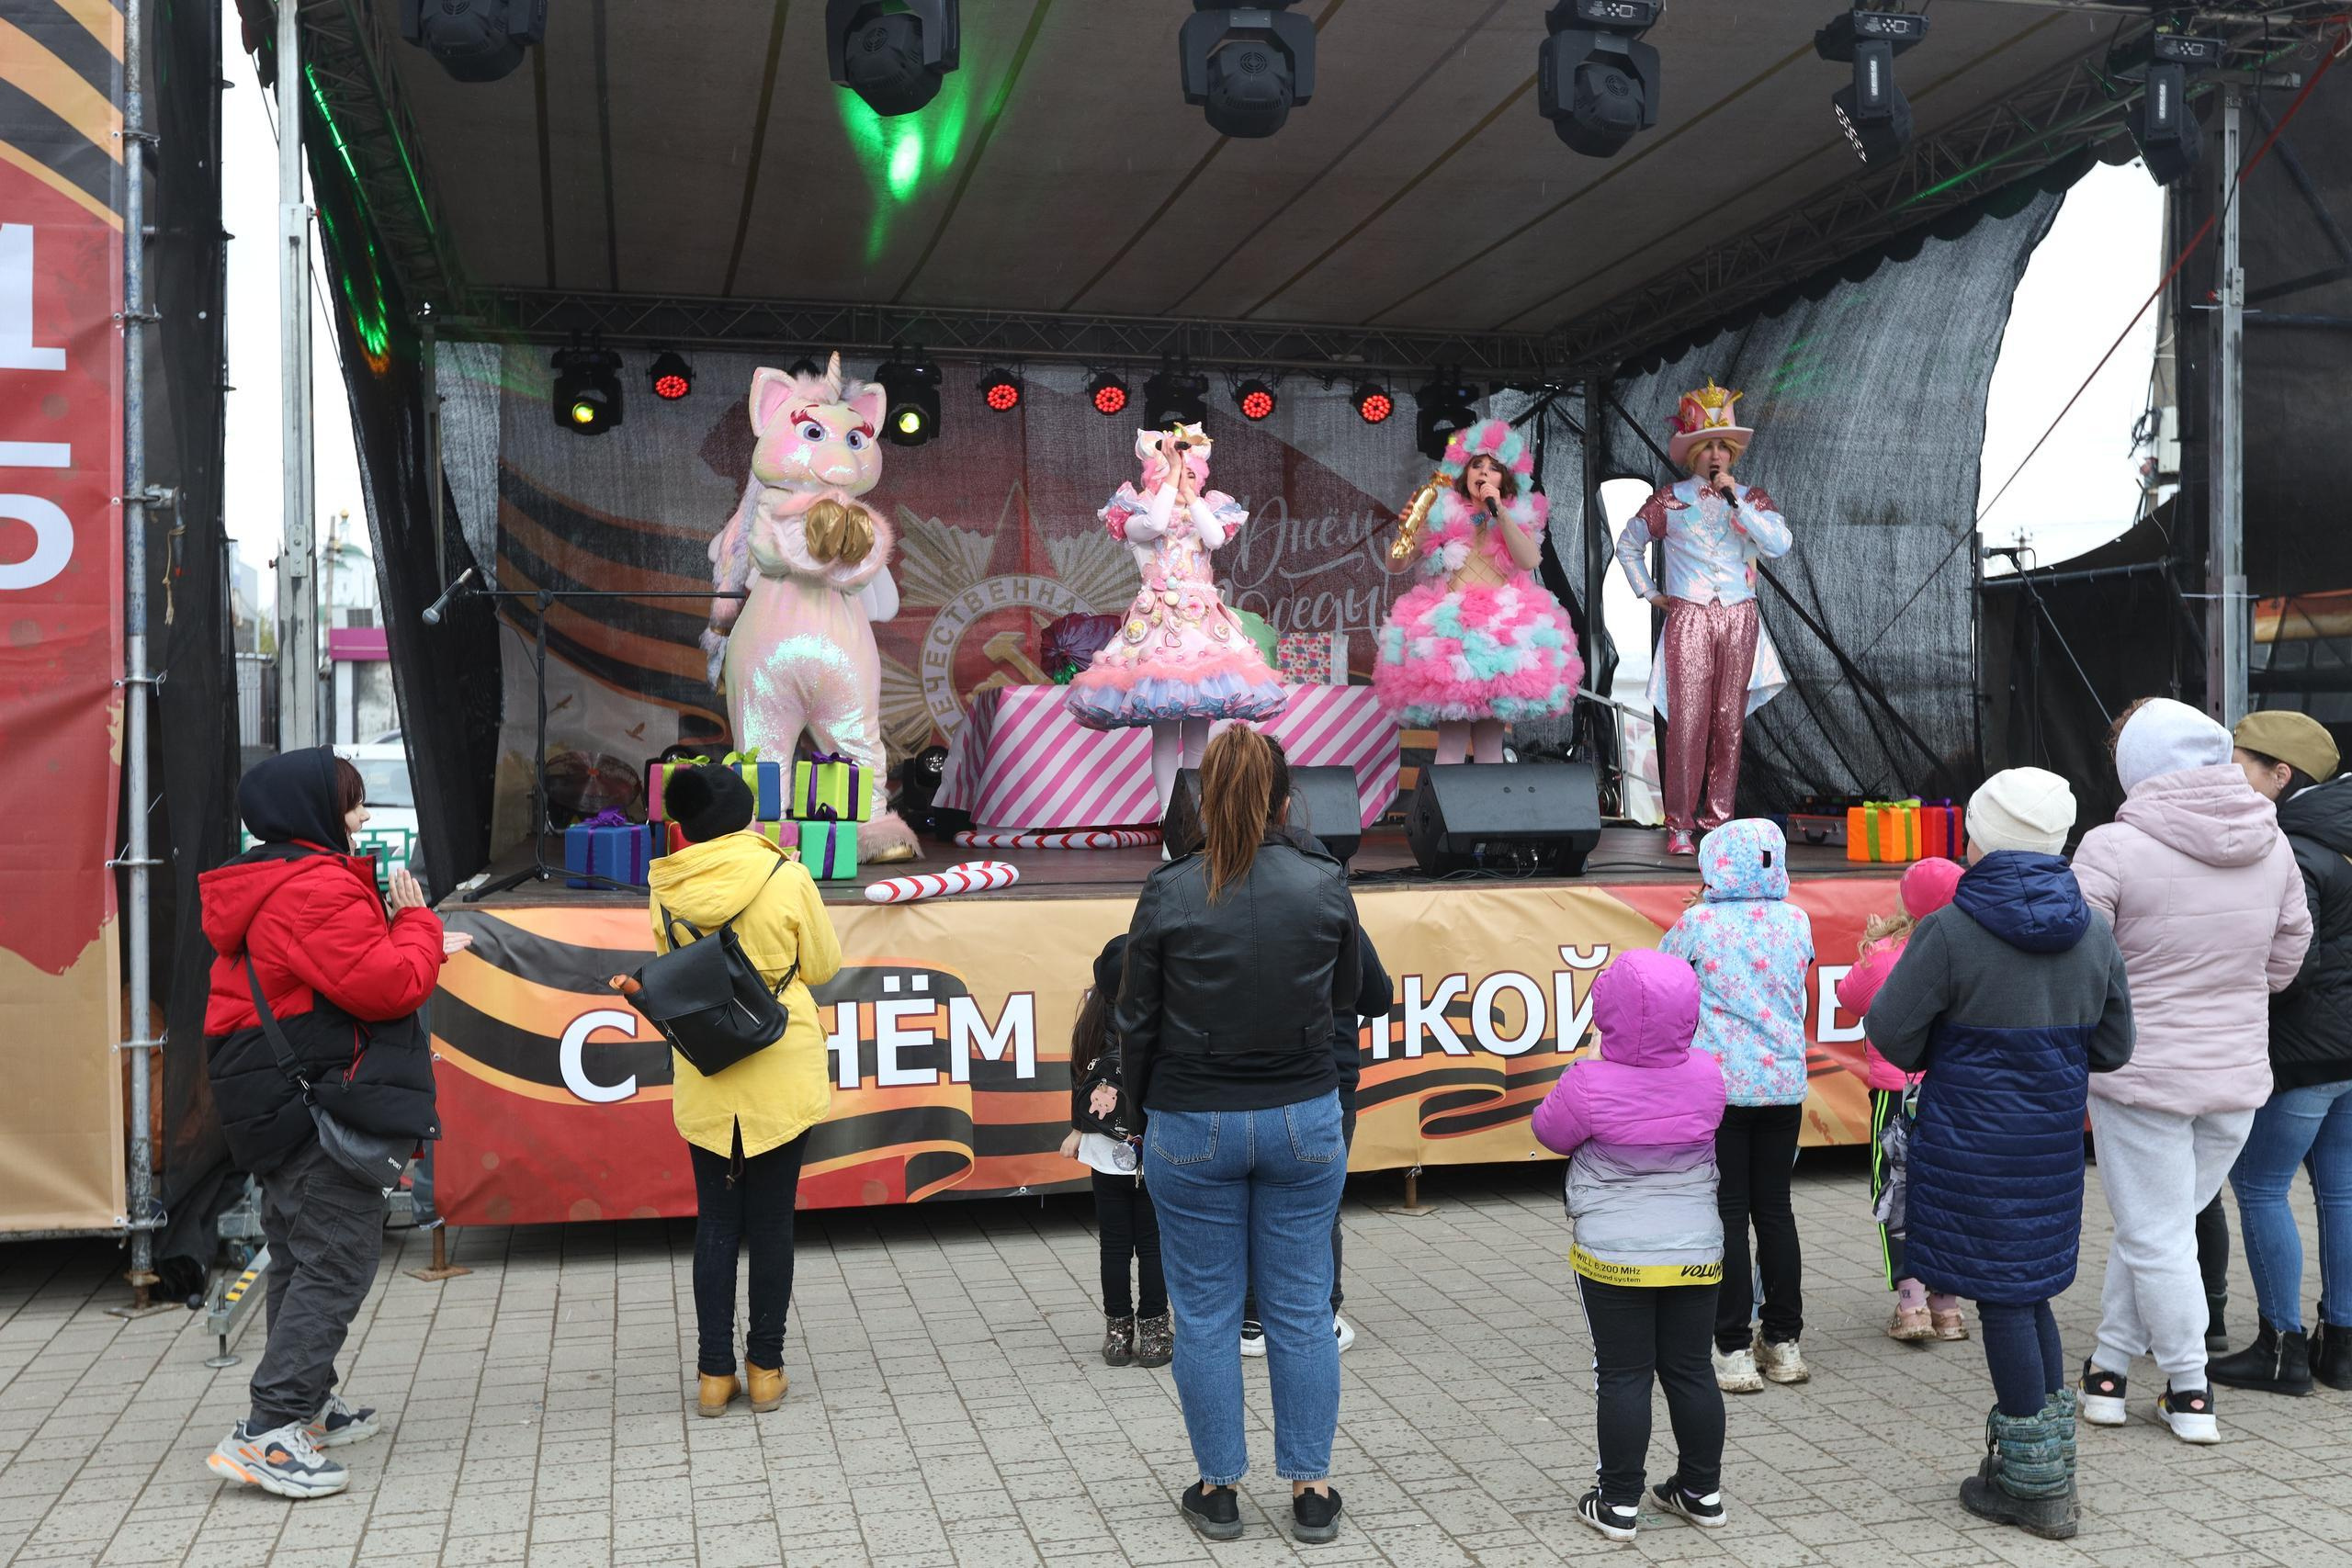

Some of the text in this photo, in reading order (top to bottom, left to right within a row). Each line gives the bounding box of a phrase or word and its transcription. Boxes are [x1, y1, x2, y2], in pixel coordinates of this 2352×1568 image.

[559, 1008, 639, 1104] С
[1357, 943, 1609, 1061] КОЙ
[1593, 1271, 1613, 1281] sound
[1613, 1276, 1642, 1284] system
[1620, 1266, 1642, 1276] MHz
